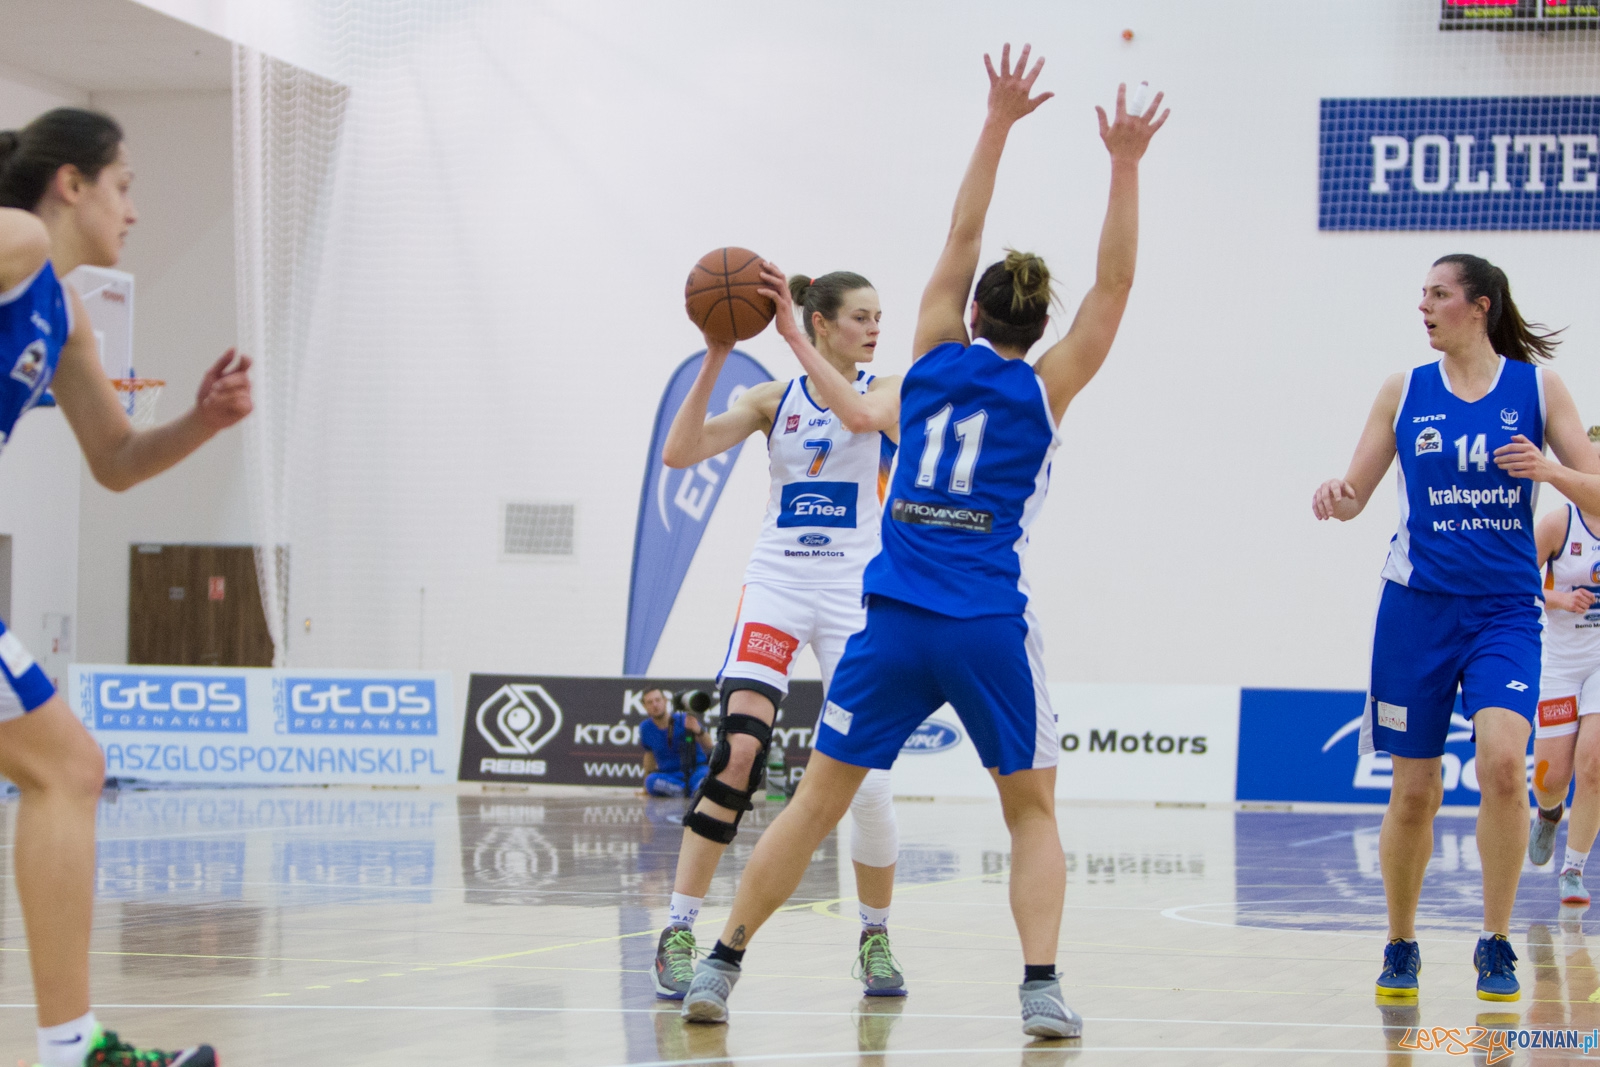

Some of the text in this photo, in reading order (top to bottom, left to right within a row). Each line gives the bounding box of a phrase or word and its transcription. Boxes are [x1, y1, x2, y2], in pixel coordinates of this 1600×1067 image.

[1412, 413, 1447, 424] zina
[804, 438, 833, 477] 7
[914, 402, 989, 496] 11
[1453, 432, 1489, 472] 14
[1428, 485, 1522, 508] kraksport.pl
[794, 501, 847, 517] Enea
[904, 503, 989, 523] PROMINENT
[1461, 518, 1522, 531] ARTHUR
[803, 534, 826, 544] Ford
[784, 549, 810, 557] Bemo
[103, 712, 241, 728] POZNAŃSKI
[294, 715, 432, 730] POZNAŃSKI
[1088, 729, 1208, 754] Motors
[103, 743, 445, 774] ASZGLOSPOZNANSKI.PL
